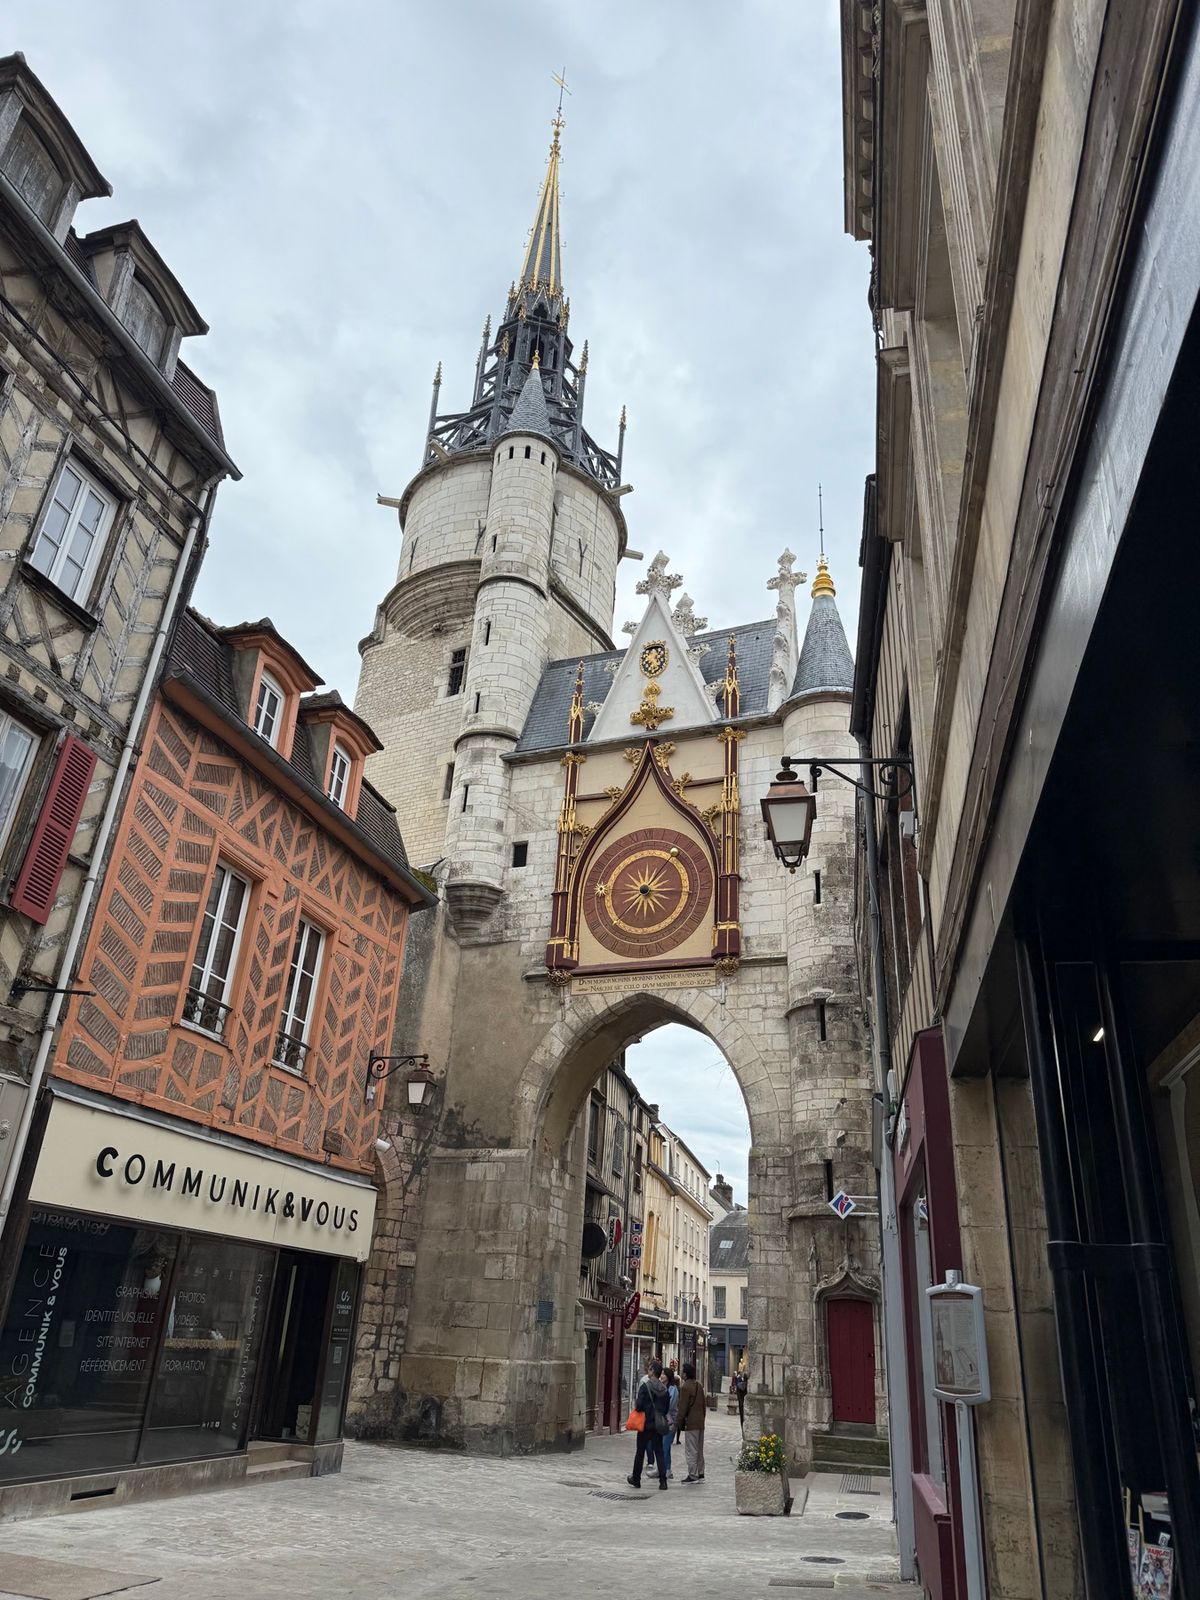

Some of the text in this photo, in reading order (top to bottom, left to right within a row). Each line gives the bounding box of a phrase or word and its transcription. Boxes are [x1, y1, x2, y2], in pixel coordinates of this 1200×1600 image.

[115, 1285, 160, 1300] GRAPHISME
[178, 1290, 206, 1304] PHOTOS
[84, 1308, 156, 1324] IDENTITÉ VISUELLE
[625, 1296, 639, 1326] TABAC
[4, 1243, 56, 1409] AGENCE
[175, 1312, 200, 1326] VIDÉOS
[23, 1247, 68, 1408] COMMUNIK & VOUS
[96, 1335, 151, 1349] SITE INTERNET
[79, 1358, 147, 1372] RÉFÉRENCEMENT
[164, 1360, 206, 1372] FORMATION
